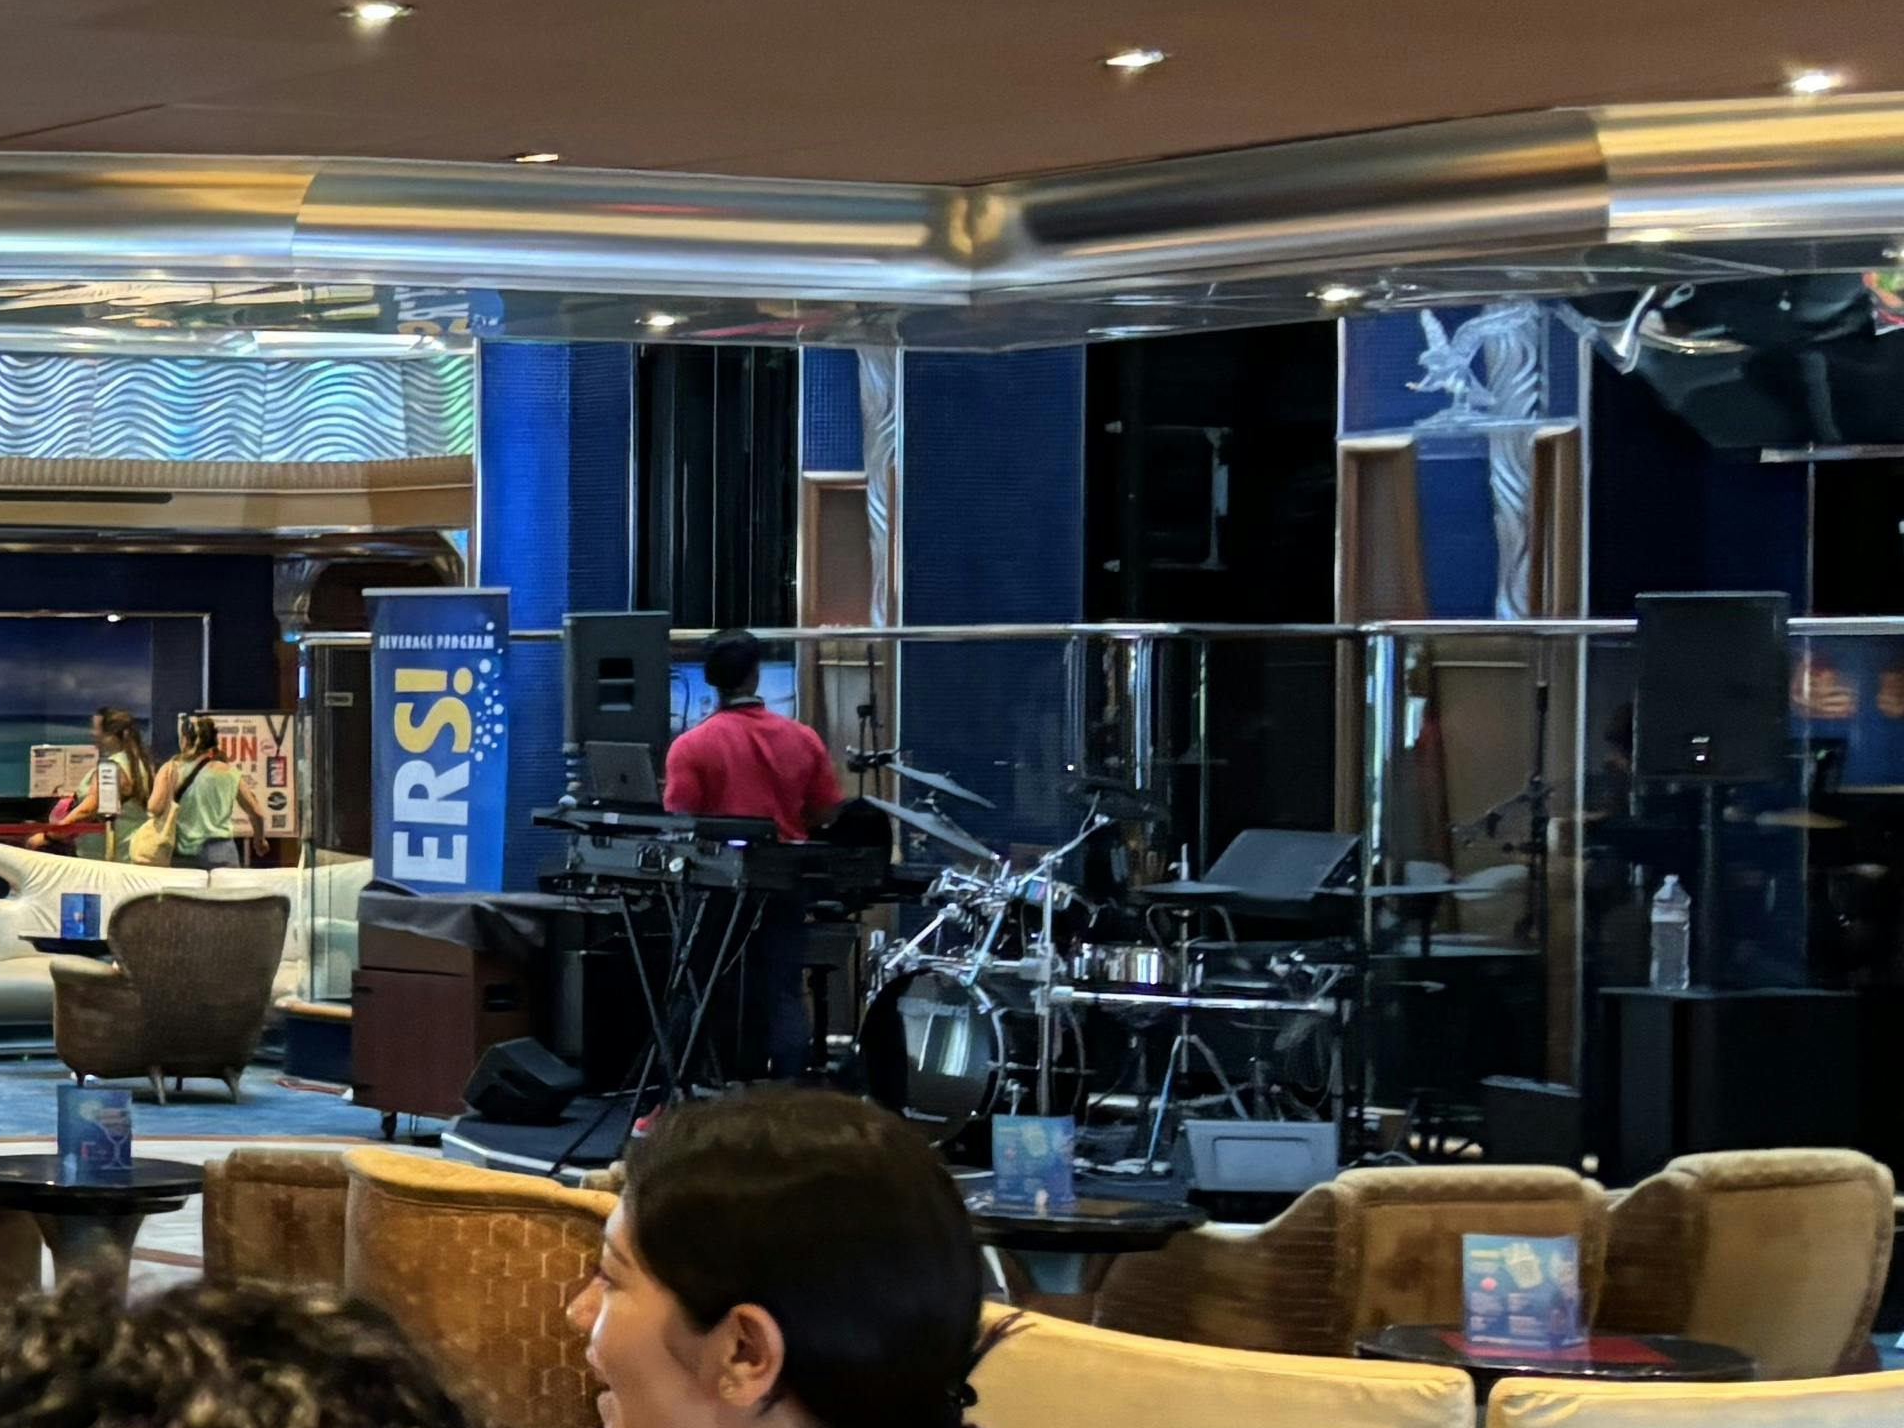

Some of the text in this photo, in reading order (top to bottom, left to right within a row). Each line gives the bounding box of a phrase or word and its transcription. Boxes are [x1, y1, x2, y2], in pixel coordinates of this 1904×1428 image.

[378, 633, 494, 650] BEVERAGE PROGRAM
[219, 735, 258, 764] UN
